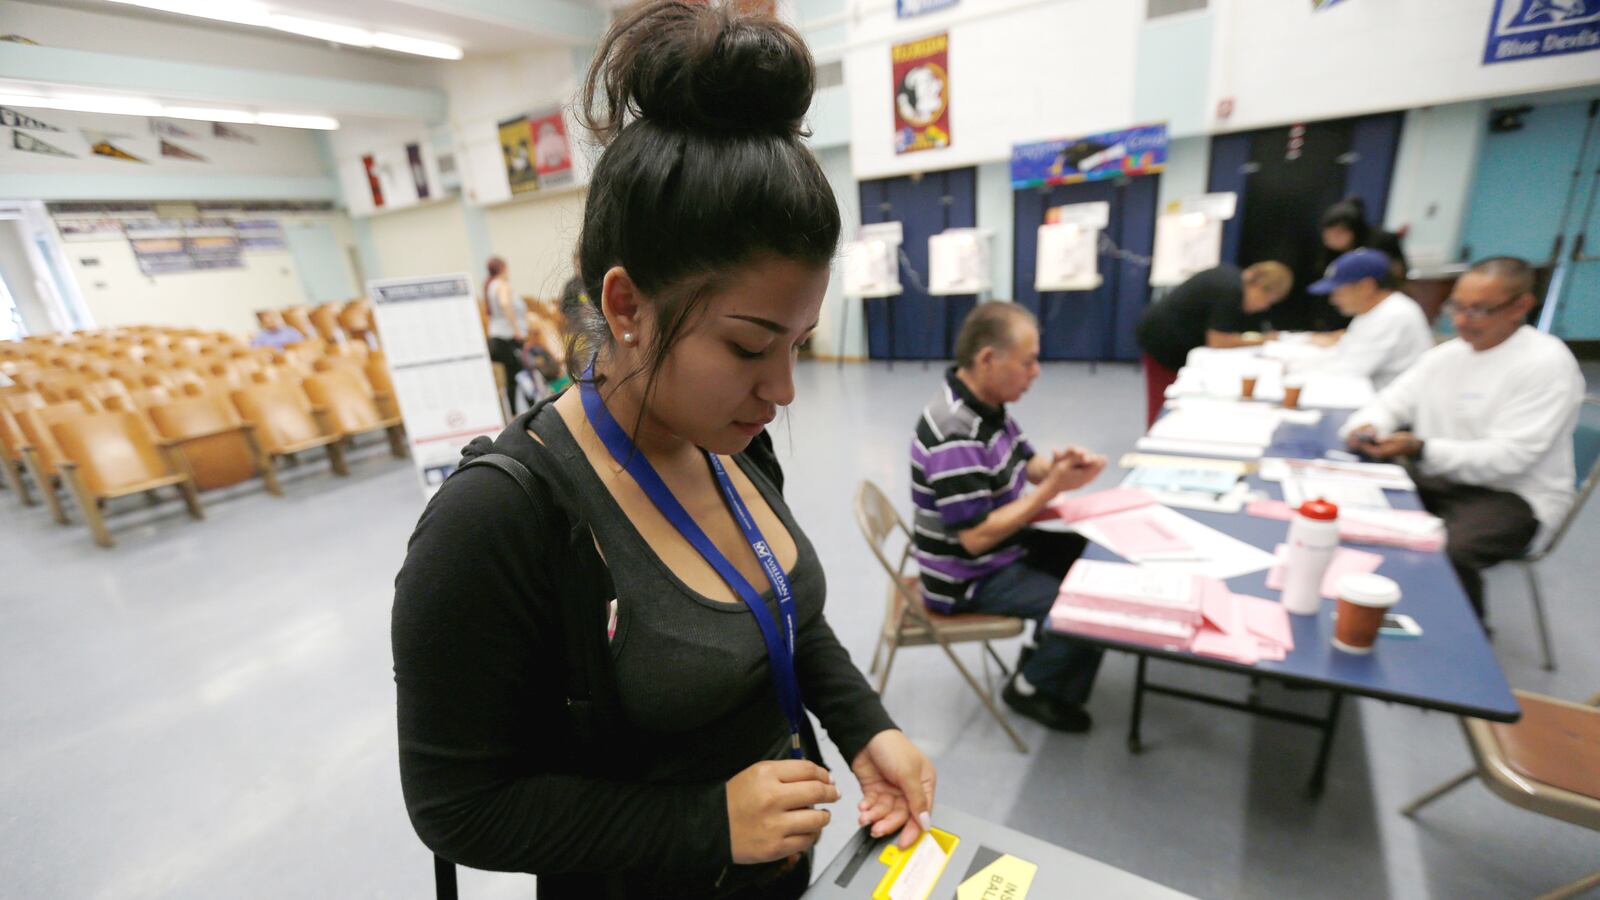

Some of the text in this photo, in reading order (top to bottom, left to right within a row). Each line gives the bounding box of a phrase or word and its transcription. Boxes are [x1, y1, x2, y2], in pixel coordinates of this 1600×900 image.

[1495, 30, 1599, 59] Blue Devils
[767, 556, 789, 597] WILLDAN
[981, 874, 1004, 900] BAL
